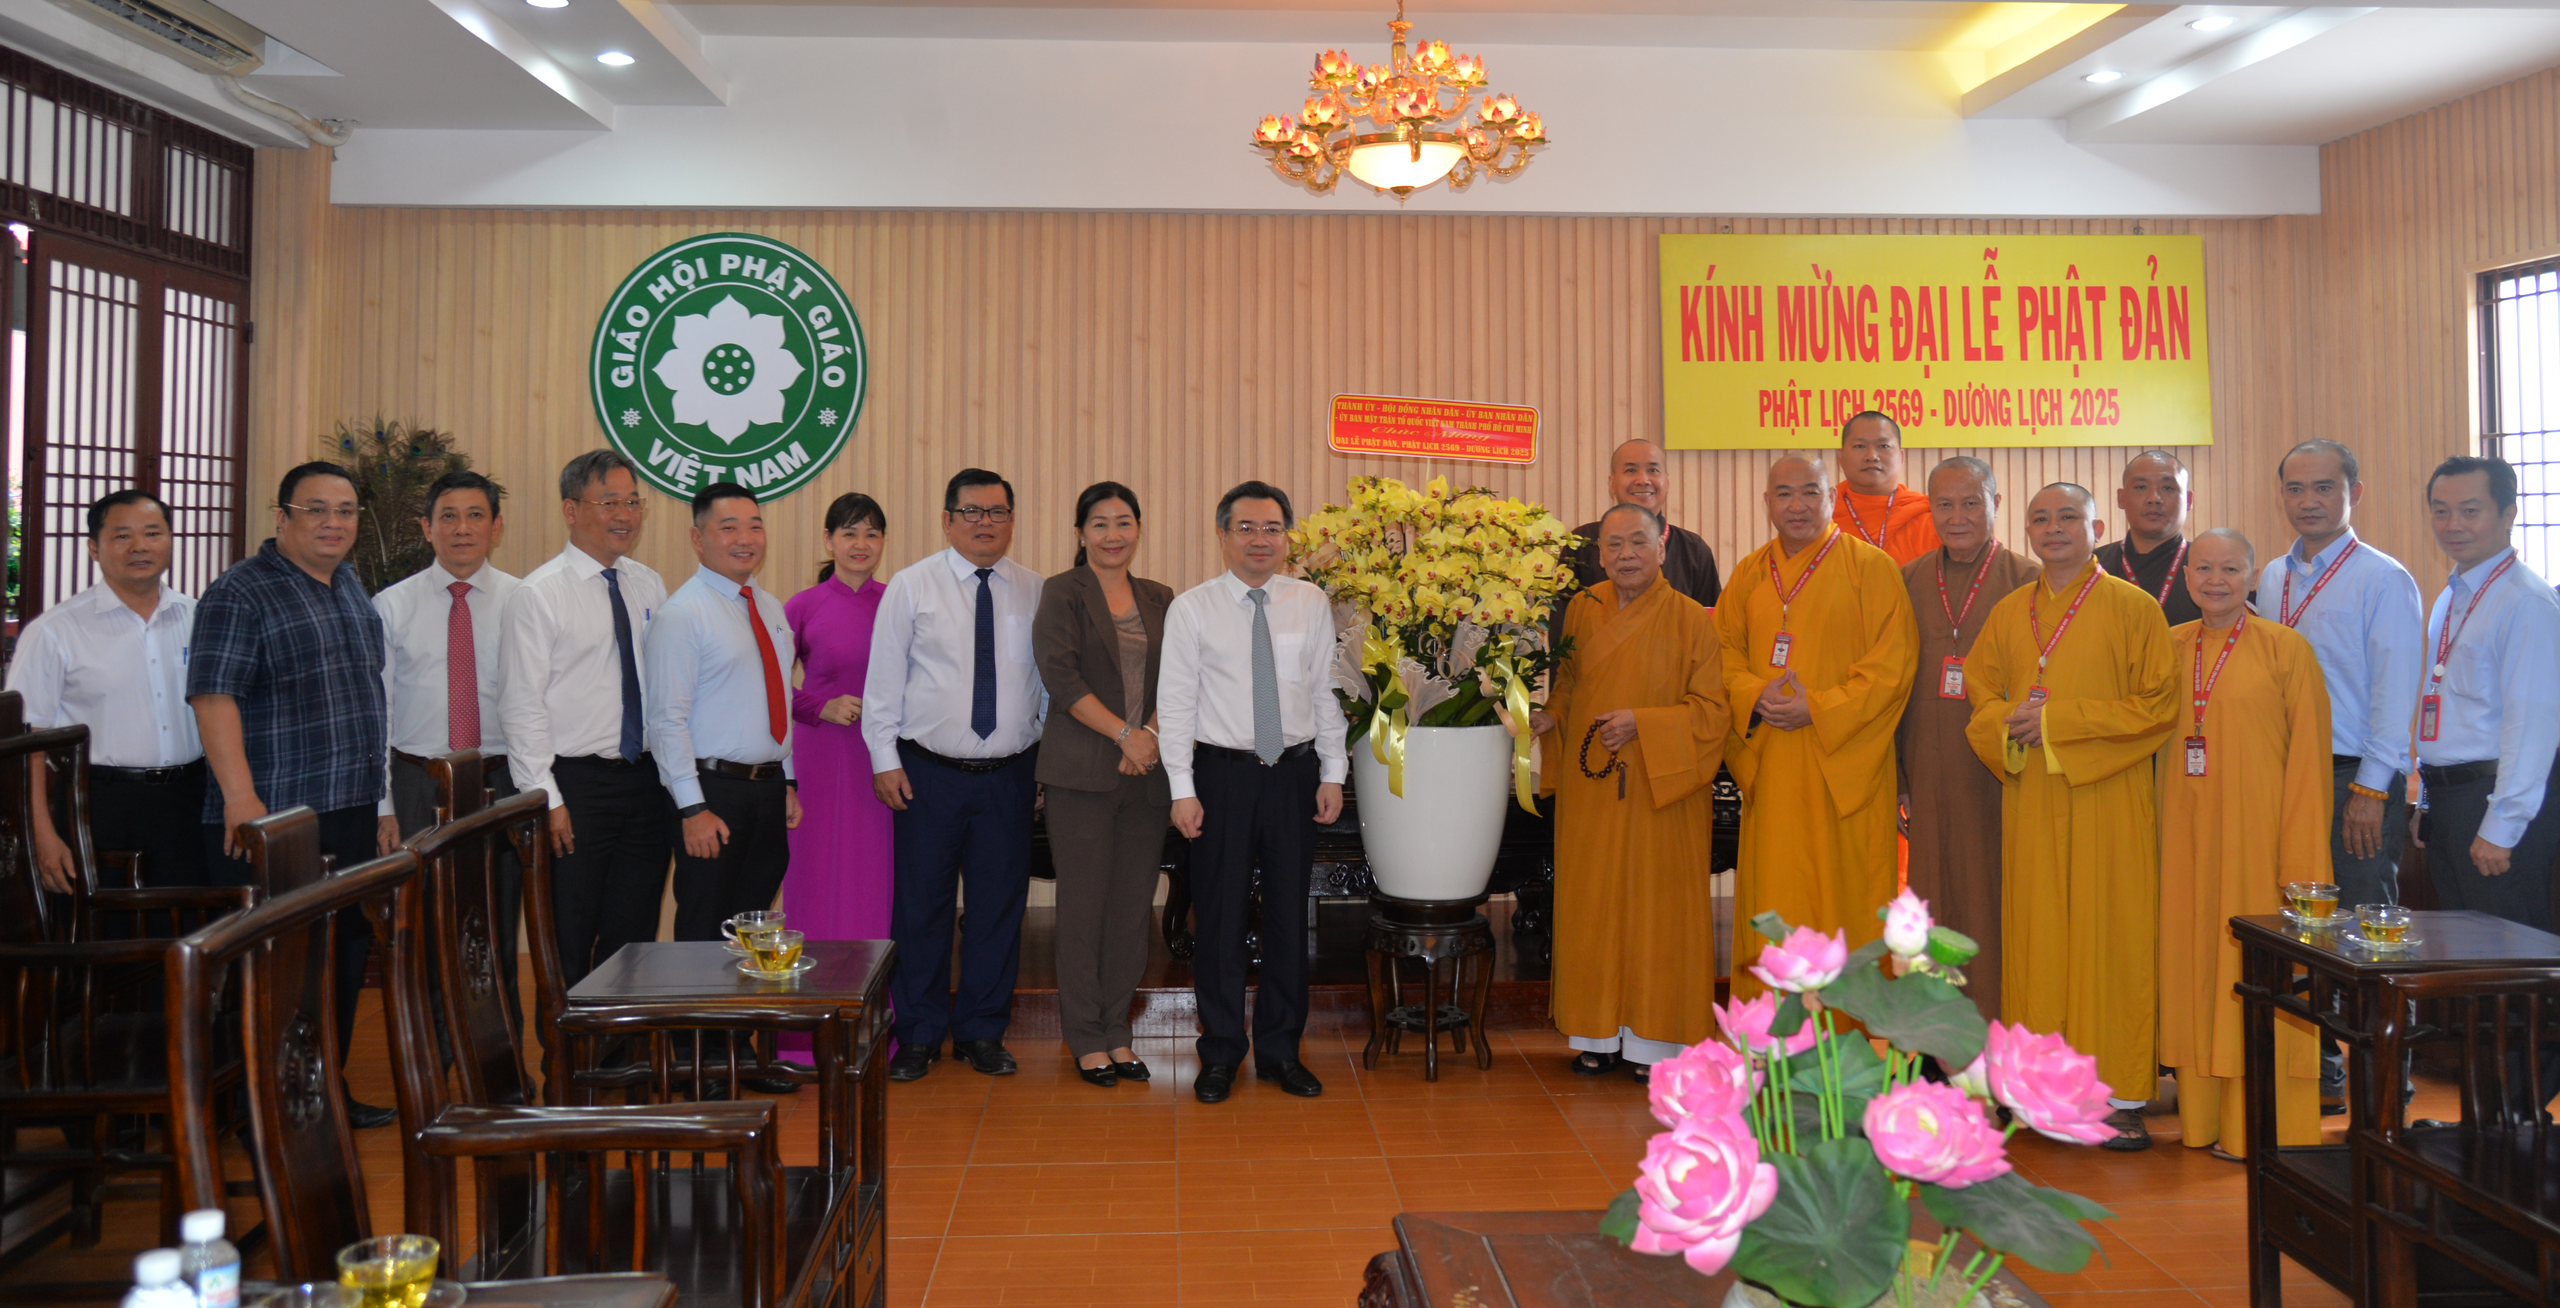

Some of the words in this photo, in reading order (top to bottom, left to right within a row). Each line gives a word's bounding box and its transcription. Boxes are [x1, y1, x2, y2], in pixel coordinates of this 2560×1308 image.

[610, 304, 650, 388] GIÁO
[647, 257, 709, 304] HỘI
[720, 253, 813, 301] PHẬT
[807, 304, 852, 388] GIÁO
[1680, 264, 1765, 362] KÍNH
[1777, 263, 1880, 364] MỪNG
[1889, 285, 1950, 379] ĐẠI
[1961, 246, 2004, 362] LỄ
[2017, 263, 2107, 378] PHẬT
[2119, 254, 2191, 361] ĐẢN
[1337, 401, 1363, 411] THÀNH
[1382, 403, 1396, 413] HỘI
[1421, 406, 1442, 416] NHÂN
[1478, 411, 1493, 420] BAN
[1349, 414, 1362, 422] BAN
[1758, 378, 1812, 436] PHẬT
[1819, 388, 1865, 437] LỊCH
[1872, 388, 1924, 428] 2569
[1943, 381, 2012, 428] DƯƠNG
[2017, 387, 2064, 436] LỊCH
[2070, 387, 2120, 427] 2025
[647, 437, 727, 490] VIỆT
[734, 440, 811, 488] NAM
[1441, 443, 1460, 452] 2569
[1510, 448, 1529, 457] 2025
